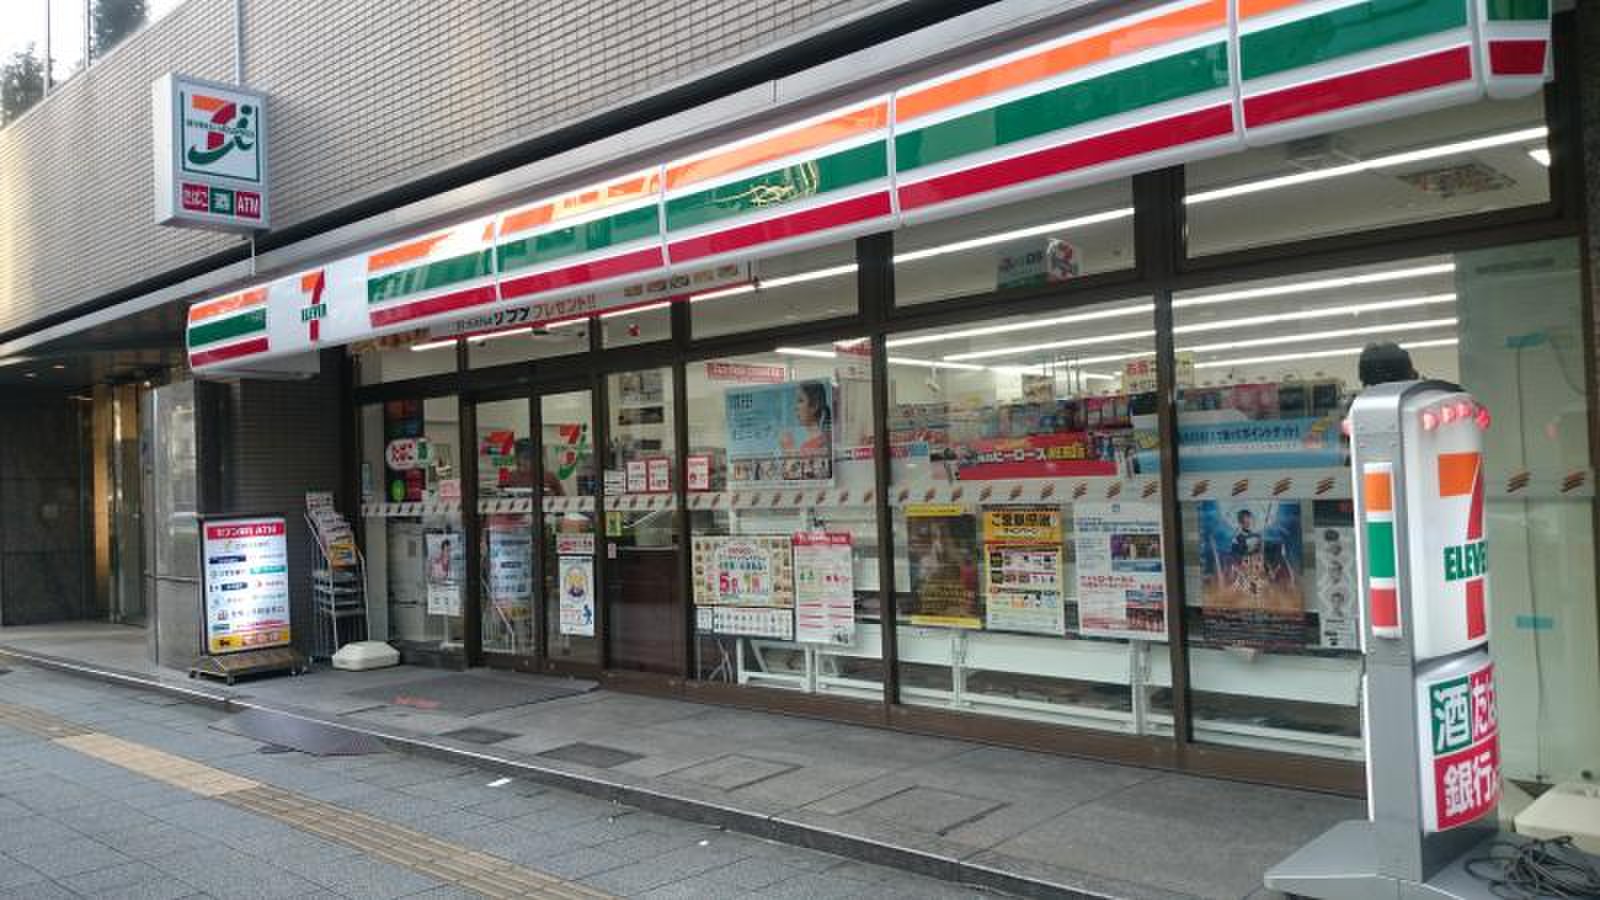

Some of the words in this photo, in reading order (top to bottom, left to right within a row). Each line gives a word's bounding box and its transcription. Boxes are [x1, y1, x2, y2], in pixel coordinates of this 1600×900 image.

[237, 195, 259, 214] ATM
[302, 269, 326, 342] 7
[1437, 452, 1487, 641] 7
[1433, 683, 1472, 752] 酒
[1443, 751, 1498, 817] 銀行
